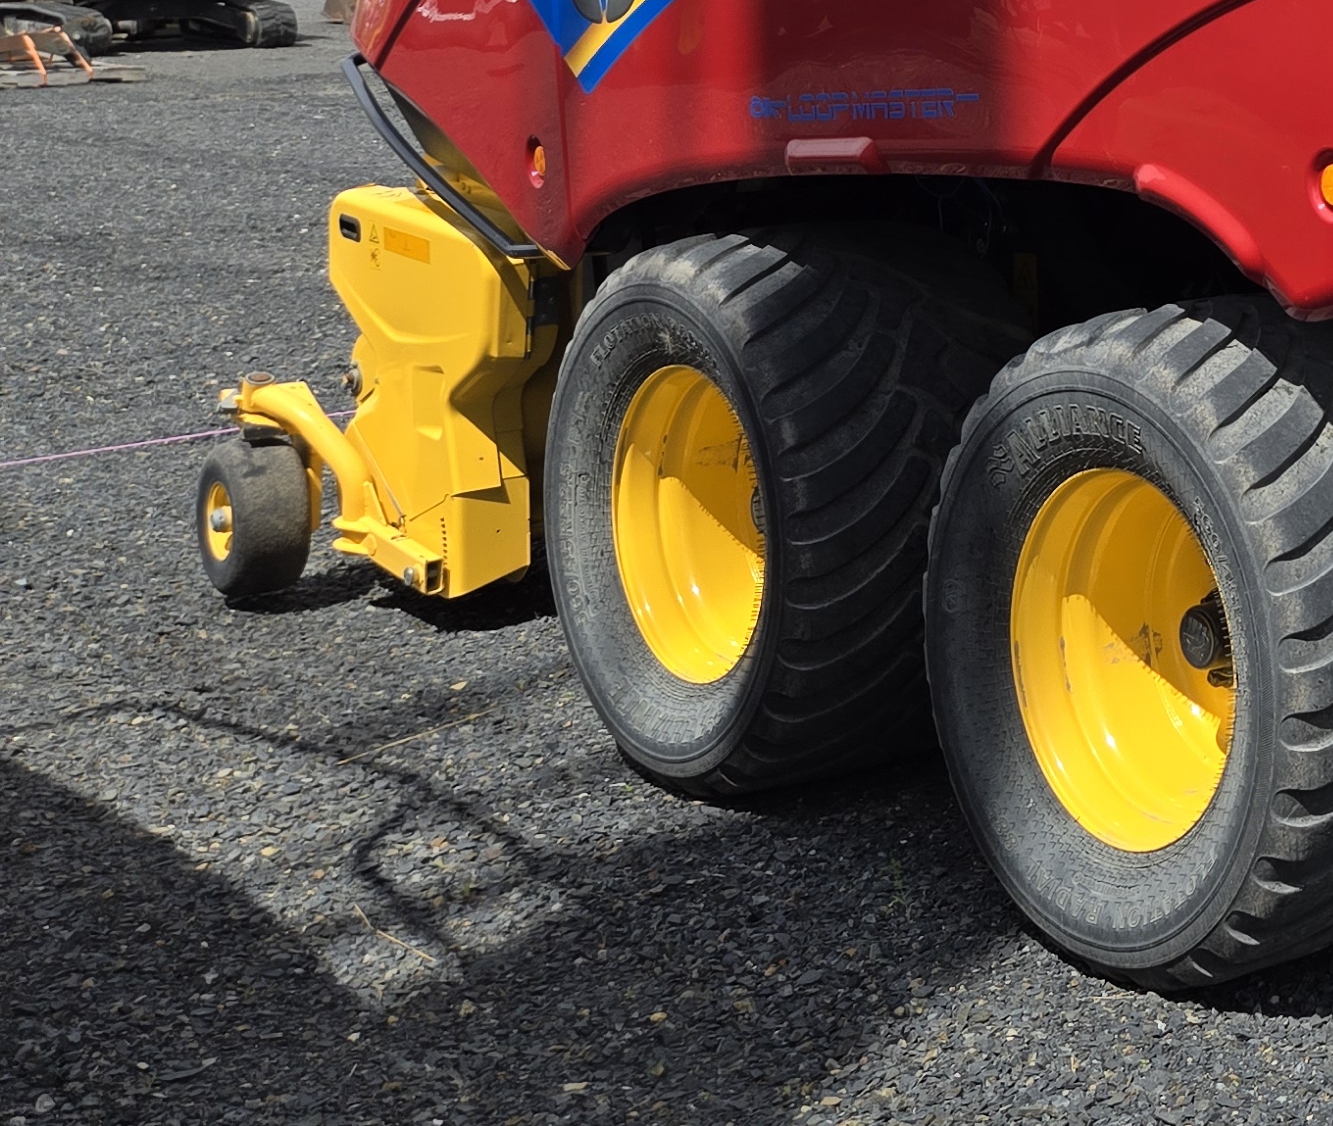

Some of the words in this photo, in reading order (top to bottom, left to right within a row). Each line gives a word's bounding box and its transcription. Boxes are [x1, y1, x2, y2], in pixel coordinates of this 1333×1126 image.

[852, 88, 956, 120] MASTER
[1006, 404, 1143, 475] ALLIANCE
[1027, 858, 1105, 925] RADIAL
